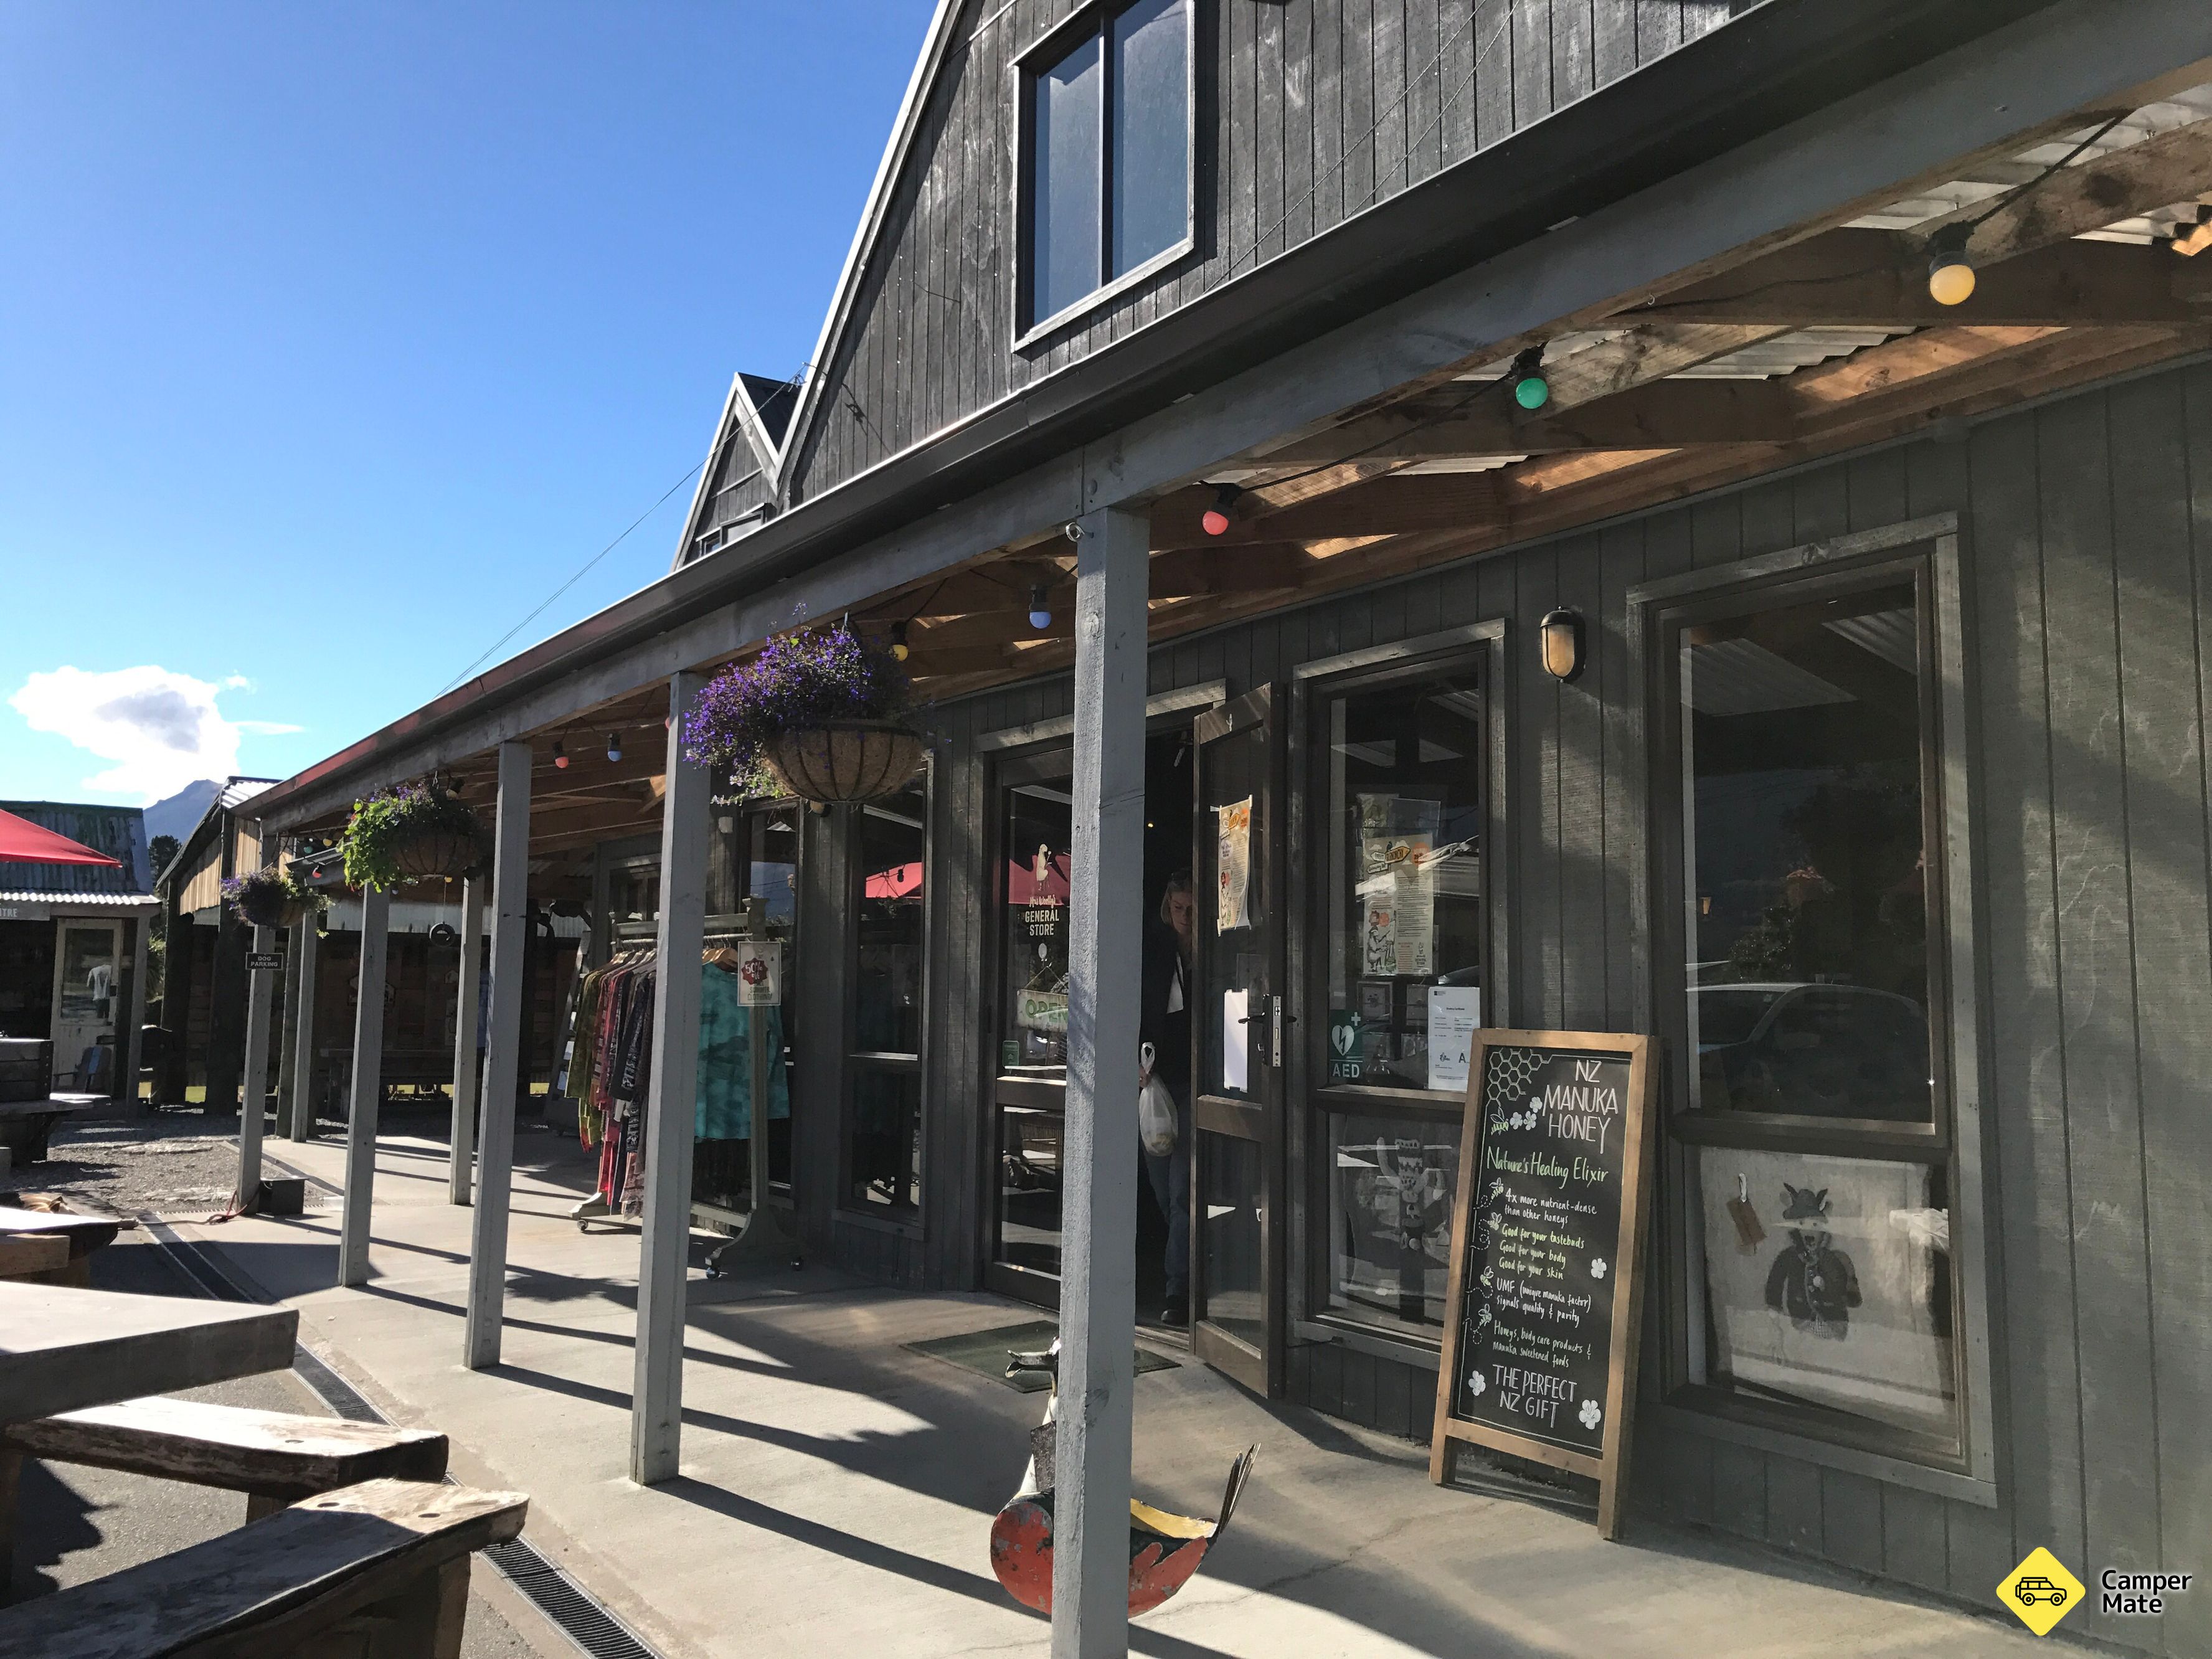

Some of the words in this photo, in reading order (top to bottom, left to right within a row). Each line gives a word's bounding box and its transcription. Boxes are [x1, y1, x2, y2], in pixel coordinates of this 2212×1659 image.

[1025, 909, 1059, 922] GENERAL
[1029, 924, 1054, 936] STORE
[745, 961, 763, 974] 50%
[1458, 1052, 1466, 1063] A
[1332, 1064, 1360, 1078] AED
[1575, 1059, 1602, 1083] NZ
[1542, 1084, 1619, 1117] MANUKA
[1548, 1113, 1612, 1155] HONEY
[1486, 1146, 1529, 1174] Nature's
[1531, 1151, 1569, 1189] Healing
[1574, 1156, 1609, 1188] Elixir
[1505, 1188, 1518, 1204] 4x
[1520, 1196, 1538, 1207] more
[1541, 1197, 1597, 1214] nutrient-dense
[1505, 1204, 1520, 1216] than
[1523, 1208, 1541, 1220] other
[1544, 1210, 1569, 1229] honeys
[1501, 1223, 1519, 1237] Good
[1520, 1228, 1531, 1242] for
[1532, 1232, 1548, 1245] your
[1550, 1231, 1585, 1249] tastebuds
[1500, 1239, 1516, 1254] Good
[1518, 1244, 1529, 1257] for
[1530, 1249, 1546, 1261] your
[1549, 1249, 1566, 1270] body
[1499, 1256, 1516, 1270] Good
[1517, 1260, 1526, 1275] for
[1528, 1265, 1543, 1277] your
[1547, 1267, 1564, 1280] skin
[1496, 1277, 1515, 1293] UMF
[1567, 1294, 1591, 1313] factor)
[1522, 1302, 1545, 1319] quality
[1557, 1309, 1580, 1328] purity
[1521, 1327, 1536, 1346] body
[1537, 1336, 1551, 1345] care
[1553, 1340, 1583, 1353] products
[1520, 1347, 1549, 1363] sweetened
[1552, 1354, 1569, 1368] foods
[1492, 1364, 1521, 1389] THE
[1522, 1370, 1577, 1402] PERFECT
[1500, 1390, 1521, 1412] NZ
[1526, 1397, 1559, 1429] GIFT
